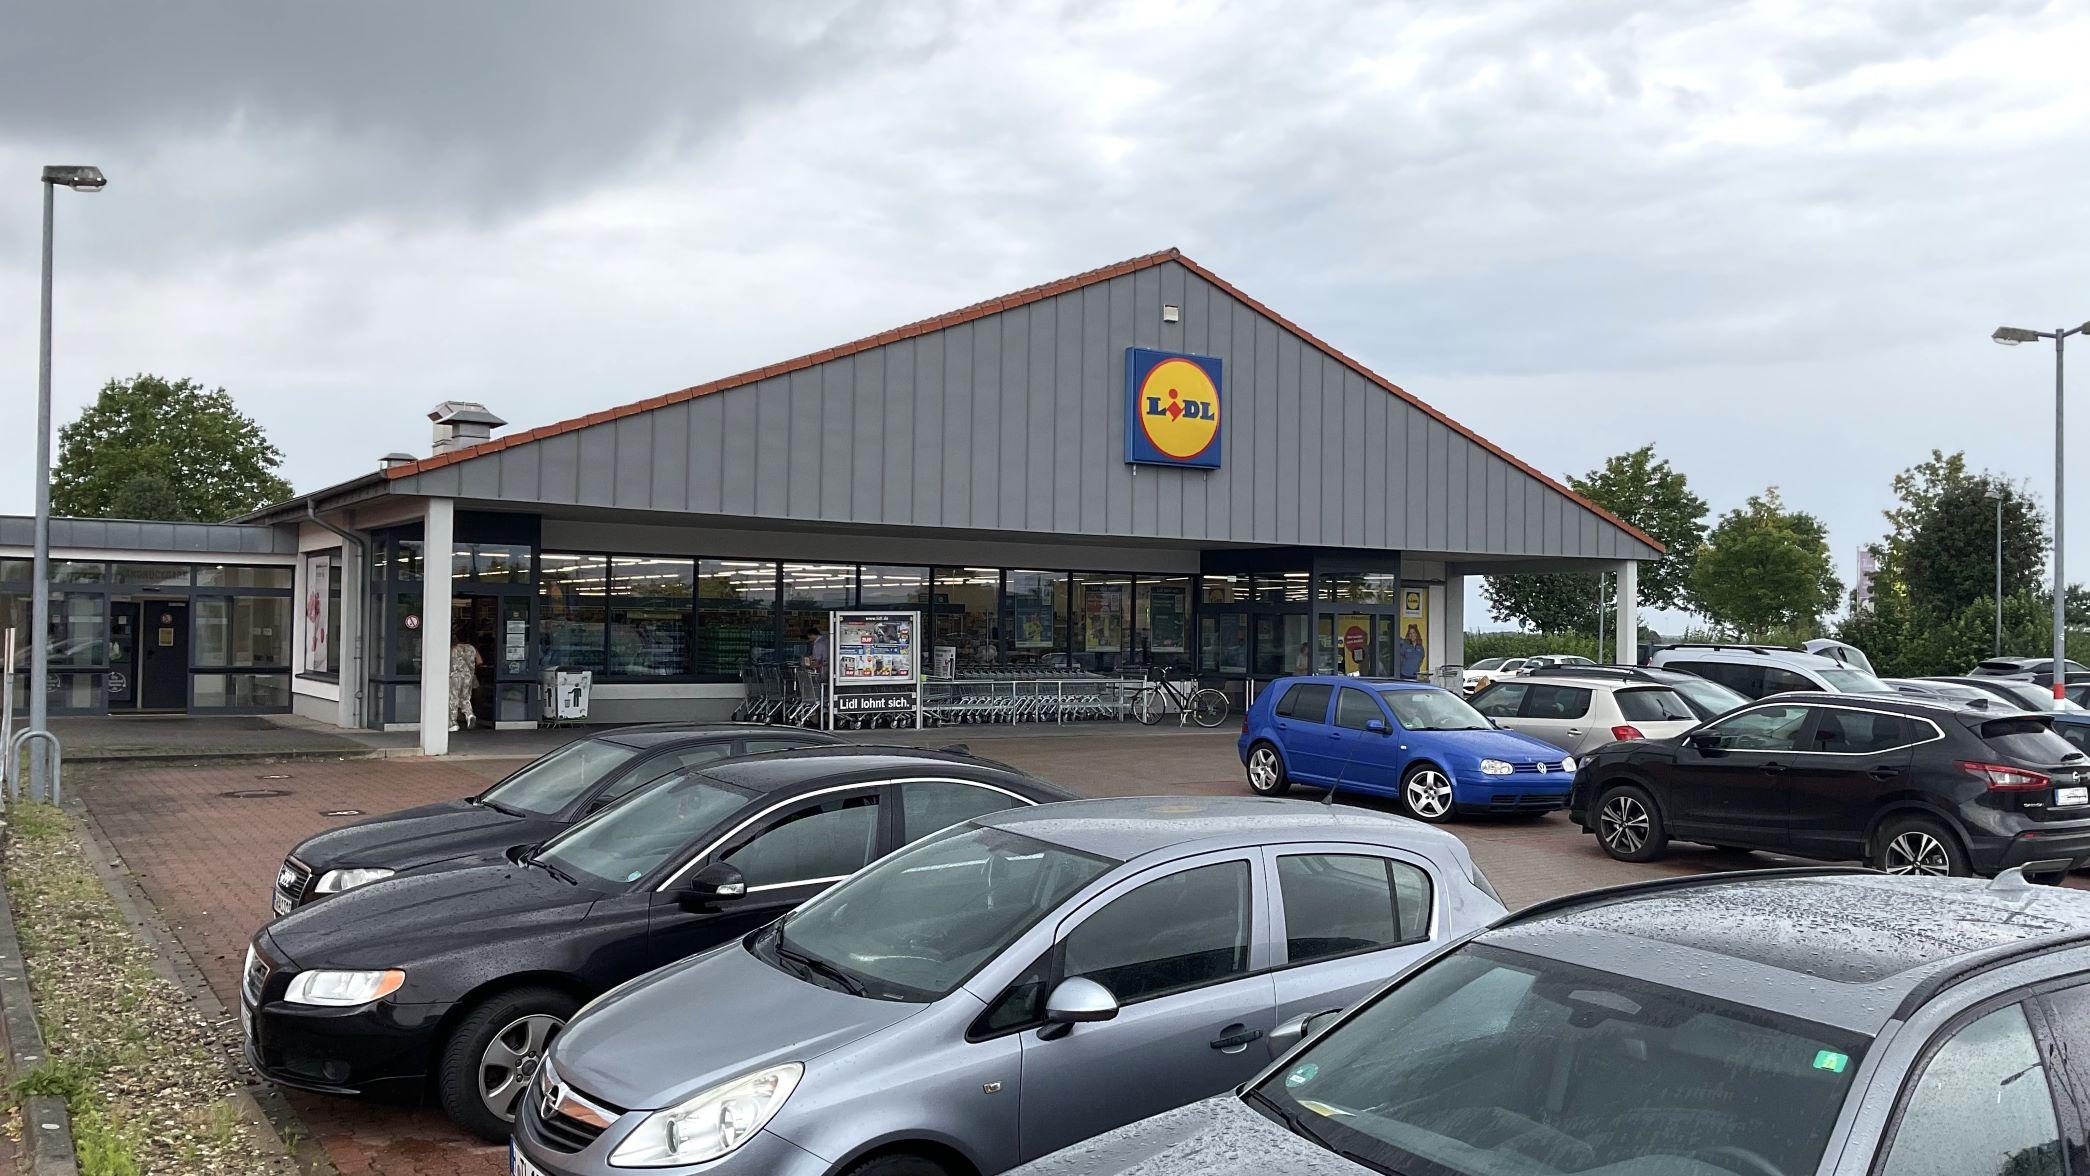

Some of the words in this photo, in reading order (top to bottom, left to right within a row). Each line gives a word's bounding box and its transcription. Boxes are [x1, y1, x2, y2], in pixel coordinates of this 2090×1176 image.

[840, 698, 857, 710] Lidl
[861, 697, 885, 709] lohnt
[888, 697, 910, 708] sich.
